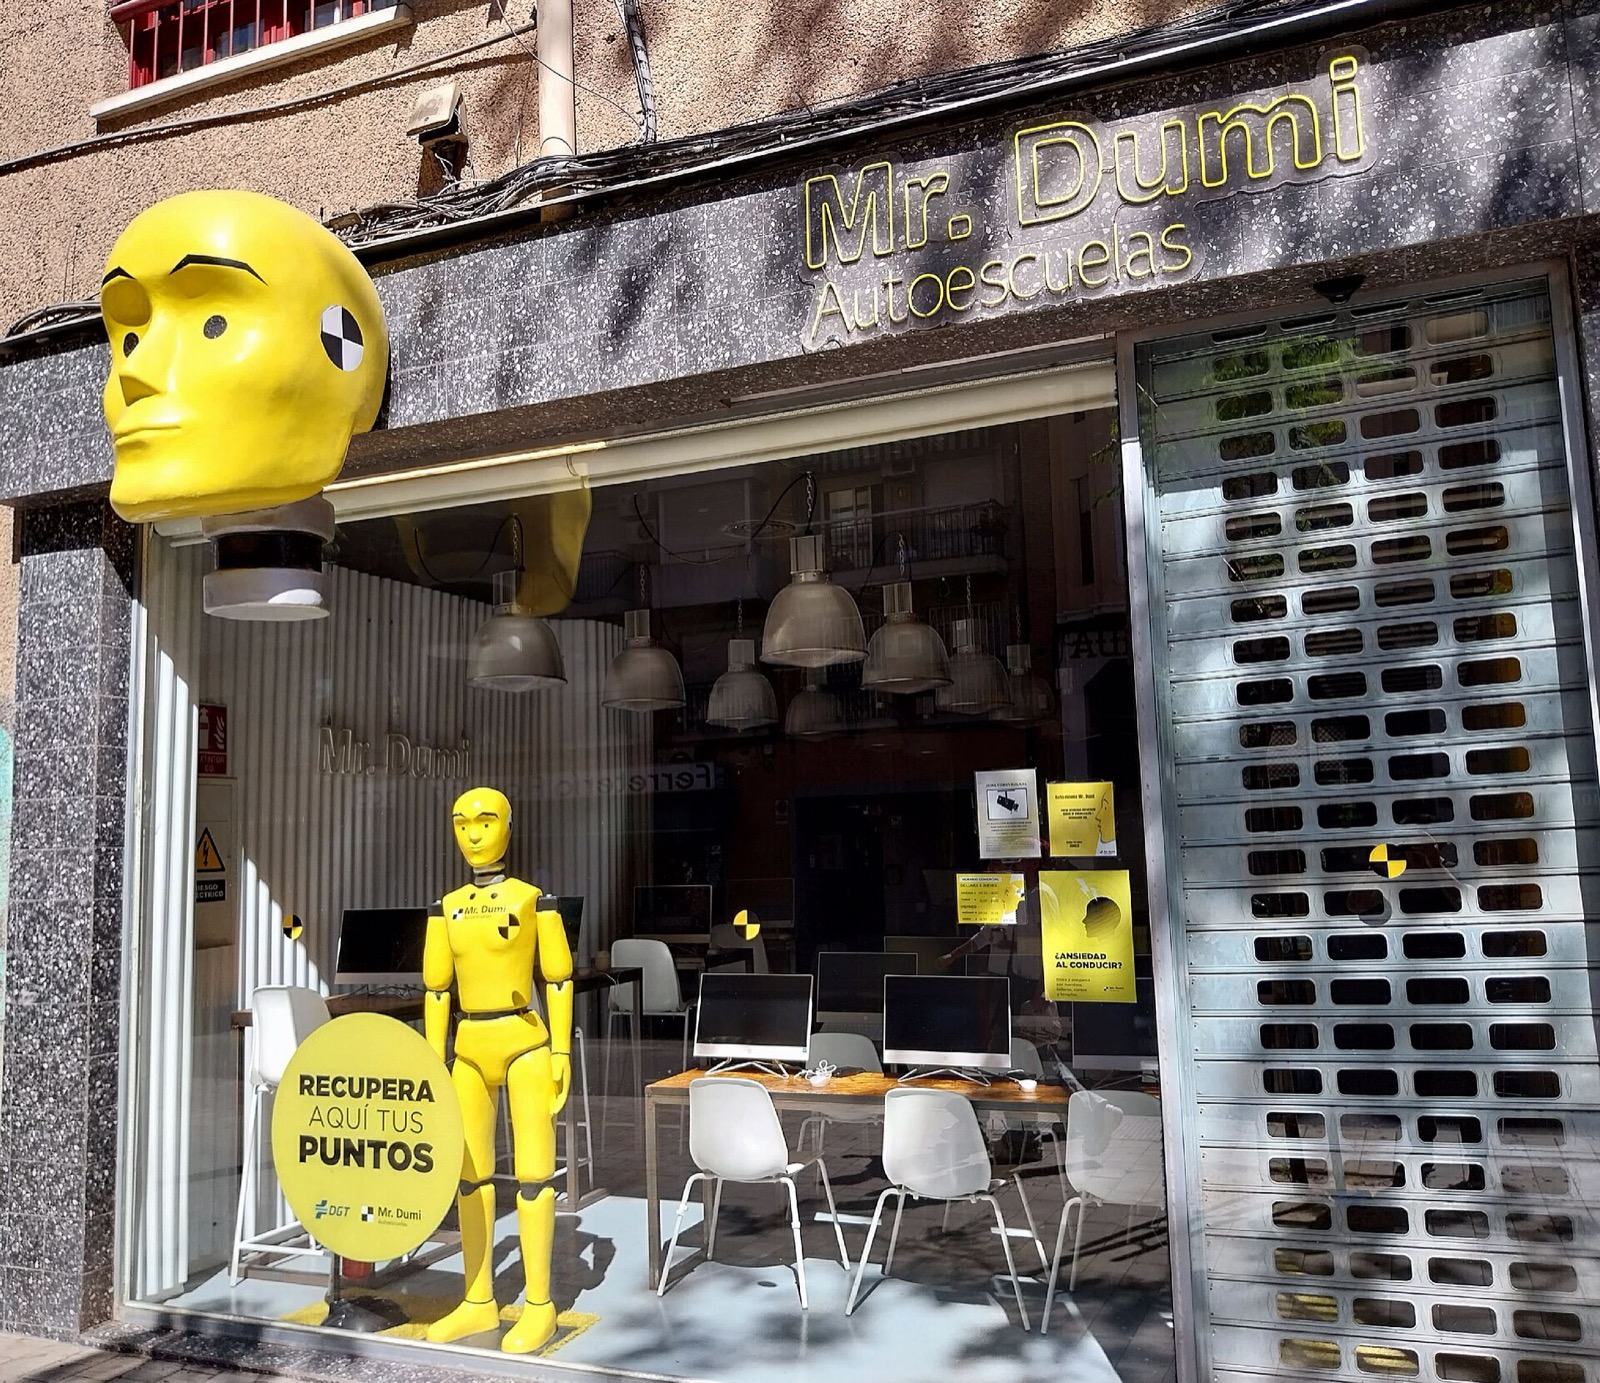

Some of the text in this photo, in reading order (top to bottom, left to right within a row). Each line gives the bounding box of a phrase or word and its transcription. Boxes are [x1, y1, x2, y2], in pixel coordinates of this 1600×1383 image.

[804, 55, 1364, 270] Mr. Dumi
[811, 223, 1192, 340] Autoescuelas
[318, 727, 470, 779] Mr. Dumi
[464, 904, 507, 915] Mr. Dumi
[1055, 952, 1107, 960] ¿ANSIEDAD
[1069, 961, 1123, 969] CONDUCIR?
[299, 1074, 436, 1103] RECUPERA
[308, 1104, 424, 1135] AQUÍ TUS
[298, 1134, 435, 1174] PUNTOS
[328, 1205, 422, 1221] DGT Mr. Dumi
